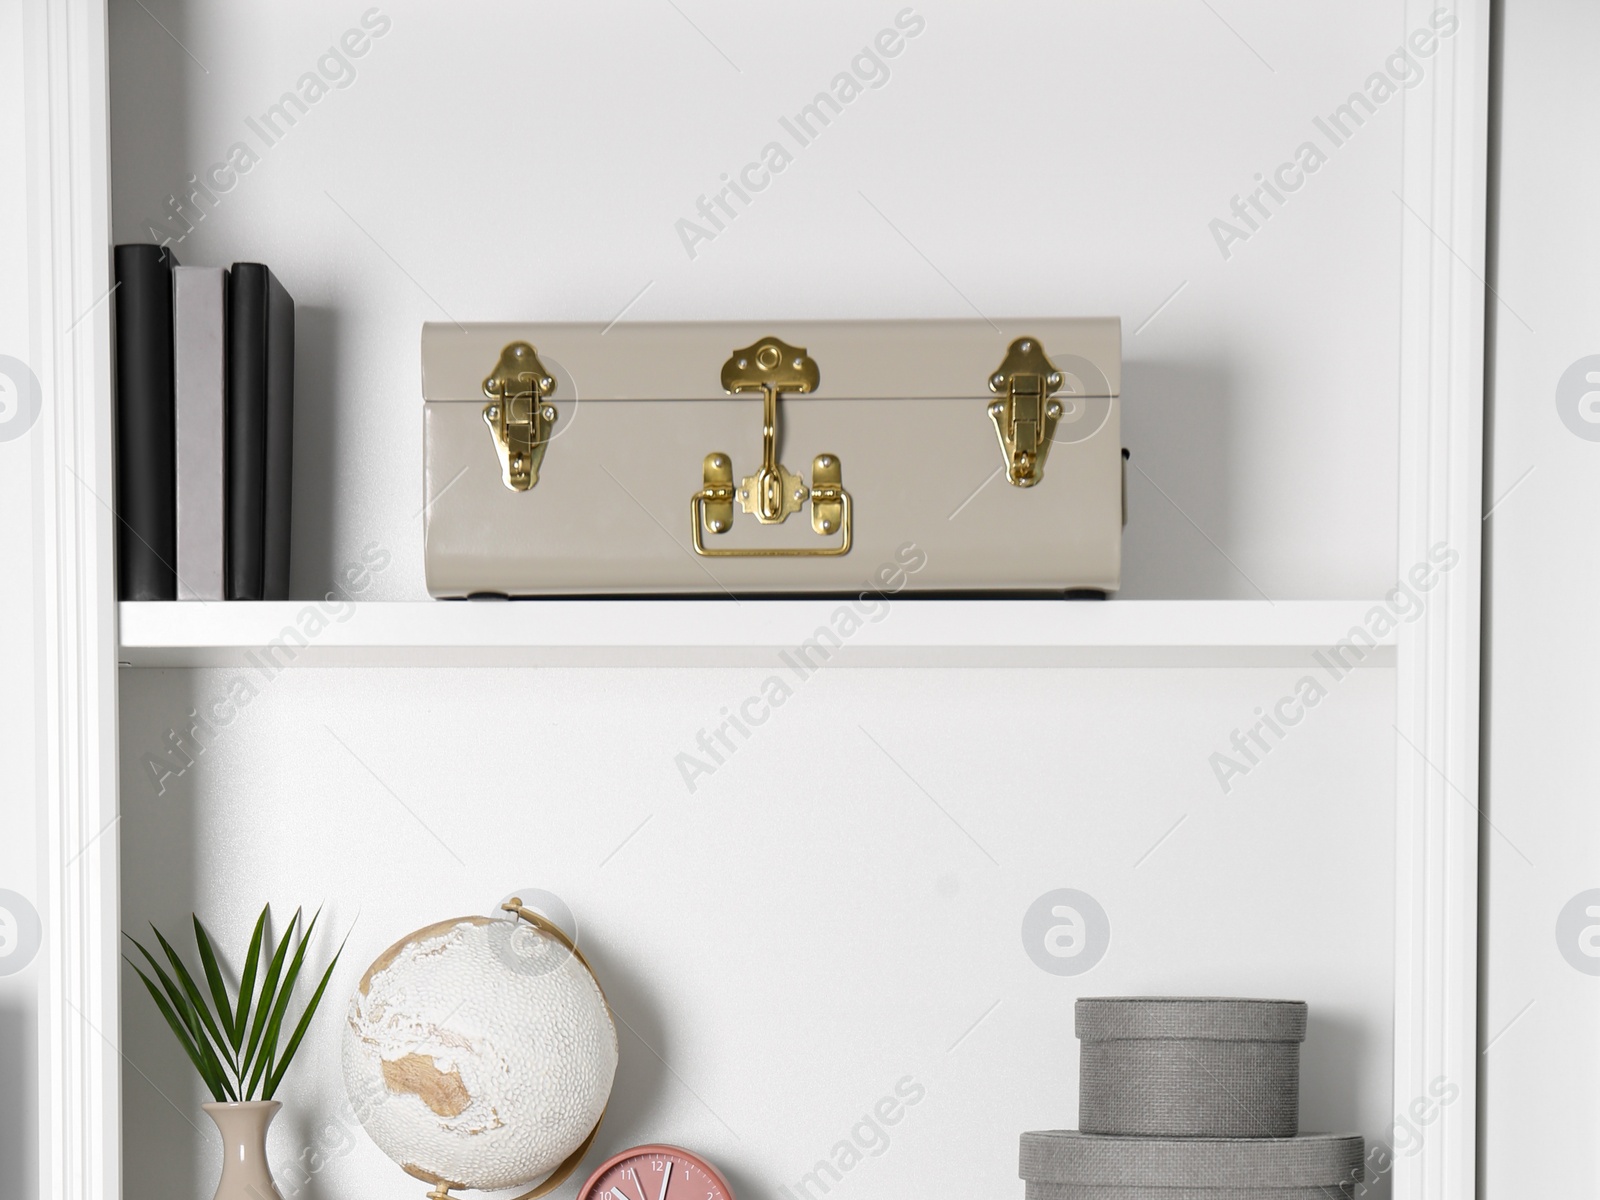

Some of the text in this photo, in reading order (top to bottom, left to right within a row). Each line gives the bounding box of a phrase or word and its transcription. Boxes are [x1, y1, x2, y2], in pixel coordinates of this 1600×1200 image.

[652, 1161, 663, 1172] 12
[621, 1169, 631, 1180] 11
[685, 1170, 689, 1180] 1
